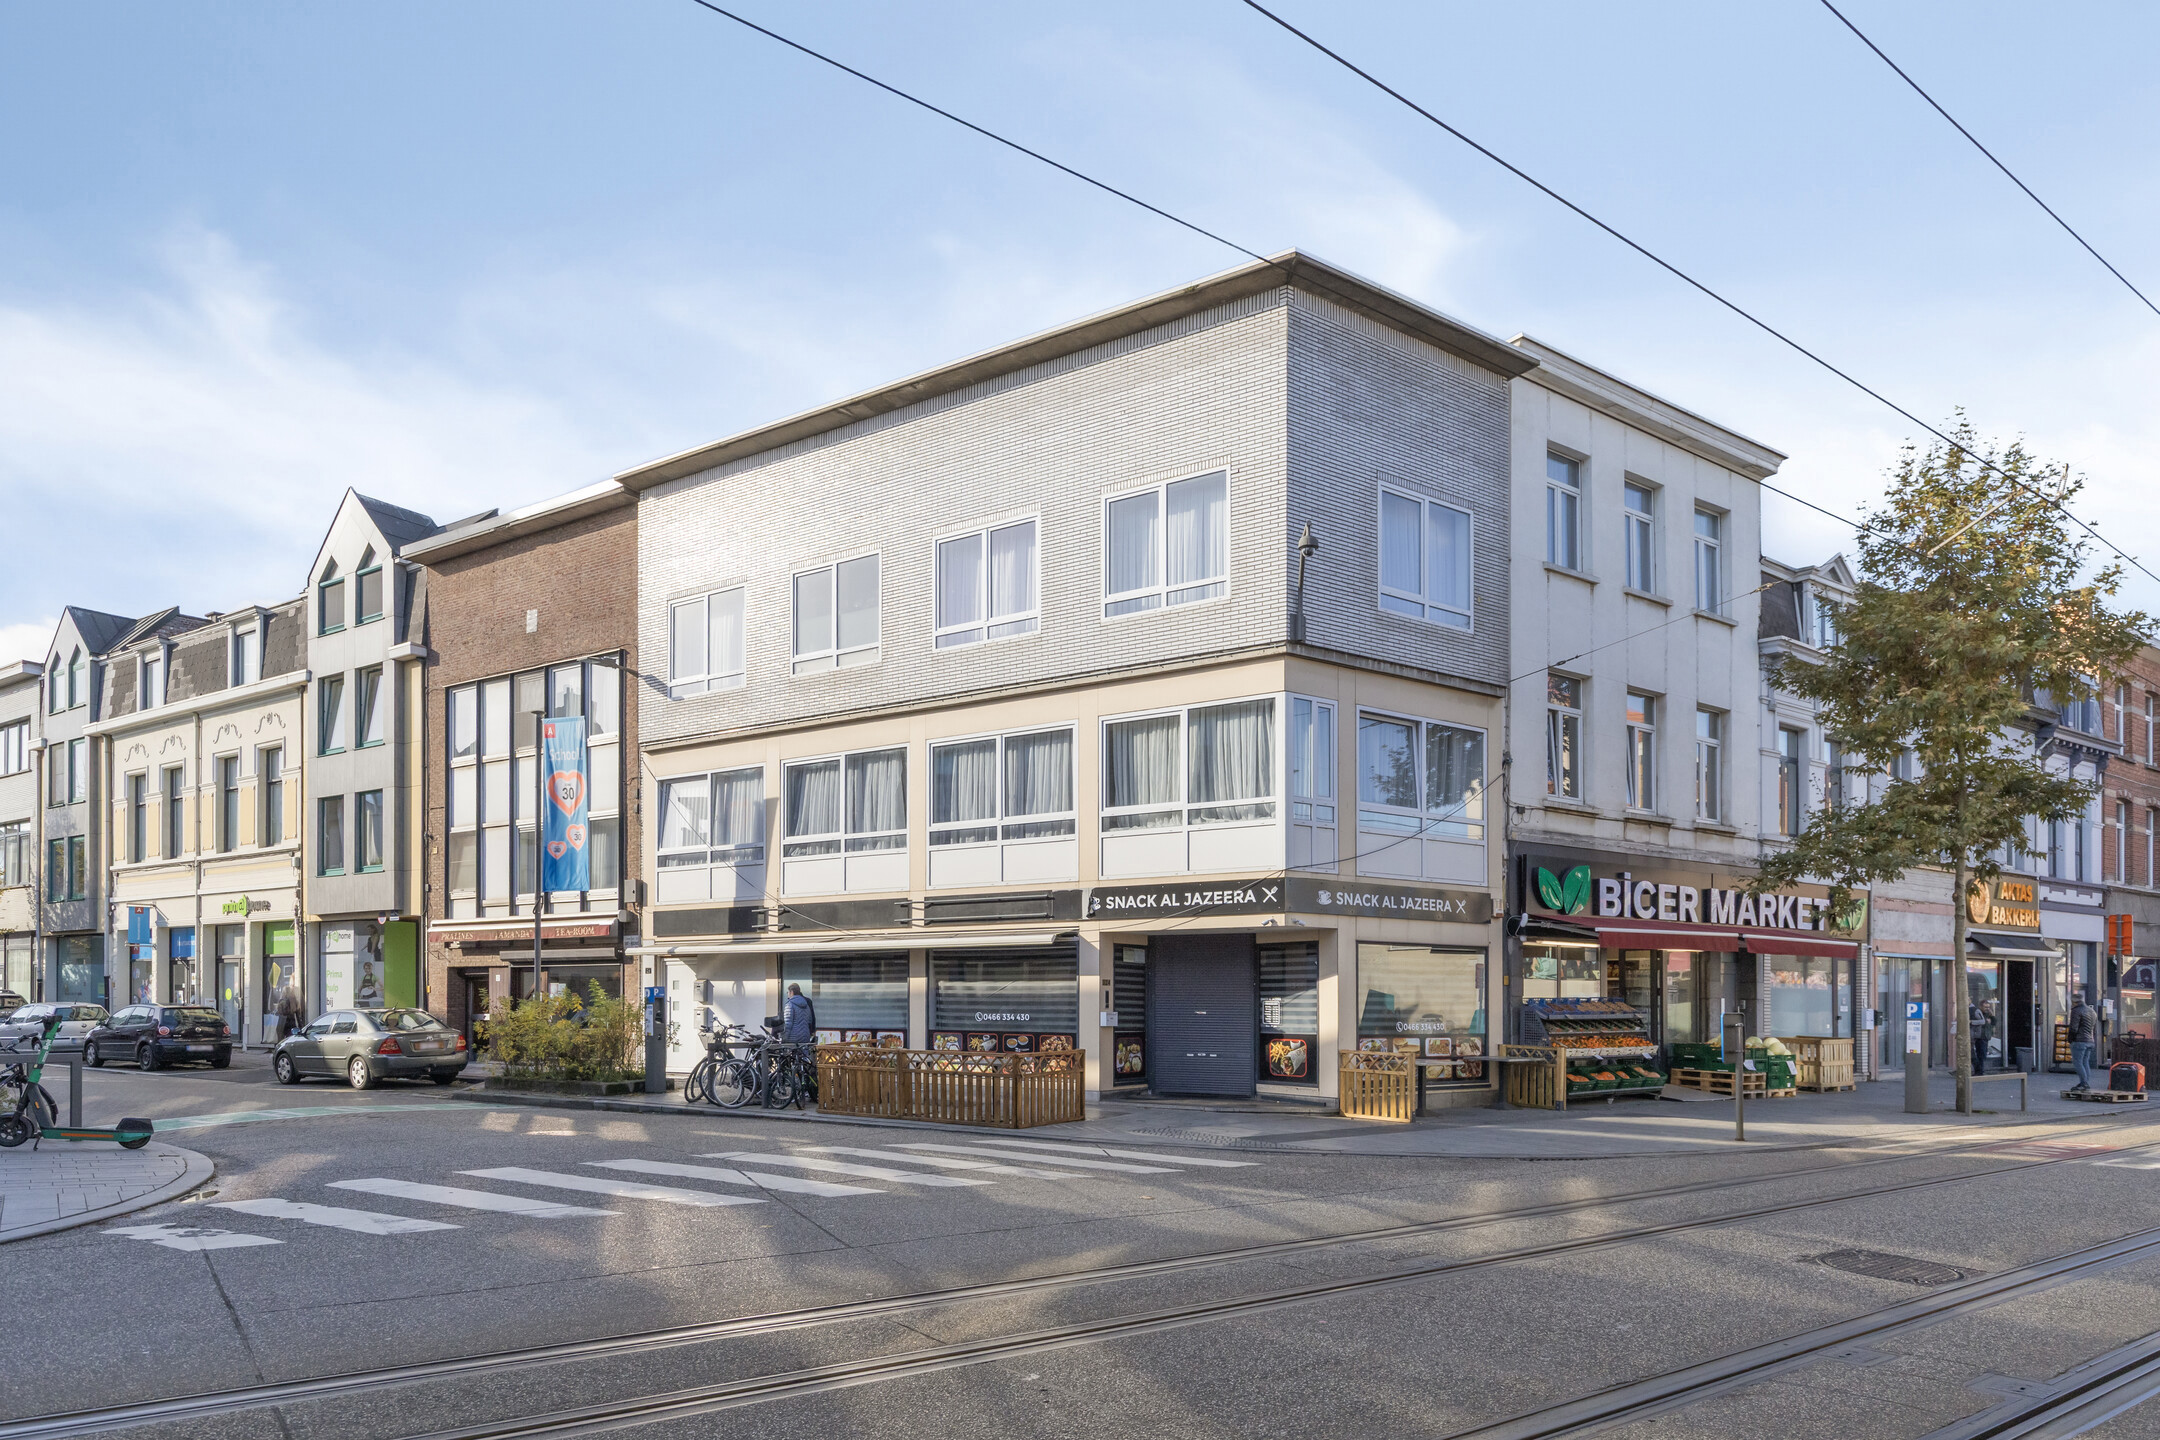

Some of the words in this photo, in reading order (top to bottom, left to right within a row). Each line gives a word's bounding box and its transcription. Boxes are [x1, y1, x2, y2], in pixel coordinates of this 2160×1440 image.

[562, 787, 575, 800] 30
[574, 833, 582, 841] 30
[1105, 894, 1158, 910] SNACK
[1160, 892, 1181, 907] AL
[1183, 889, 1257, 906] JAZEERA
[1336, 891, 1380, 907] SNACK
[1382, 895, 1398, 909] AL
[1399, 896, 1452, 913] JAZEERA
[1711, 888, 1830, 931] MARKET
[1992, 905, 2040, 928] BAKKERIJ
[441, 932, 474, 941] PRALINES
[555, 926, 595, 937] TEA-ROOM
[326, 970, 343, 979] Prima
[983, 1013, 1001, 1021] 0466
[1002, 1013, 1015, 1021] 334
[1016, 1013, 1030, 1021] 430
[1907, 1003, 1918, 1018] P
[1403, 1023, 1420, 1031] 0466
[1421, 1023, 1432, 1031] 334
[1433, 1023, 1445, 1031] 430
